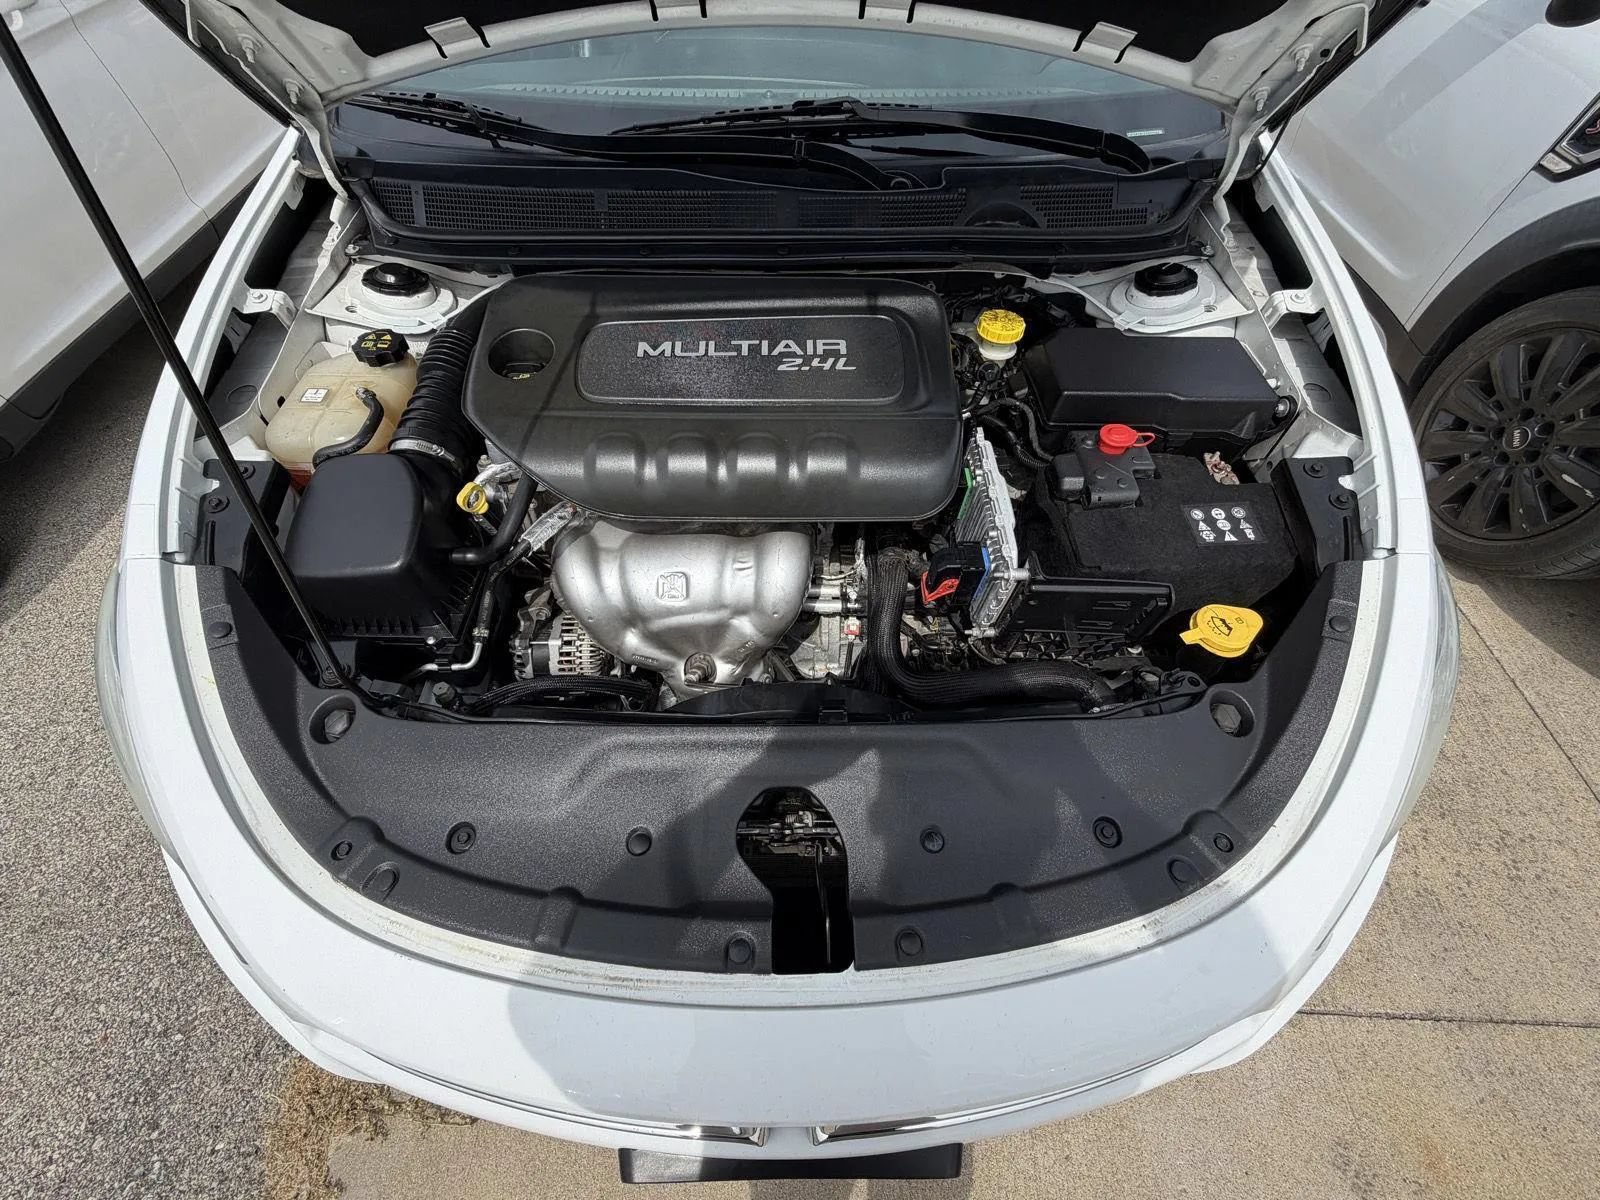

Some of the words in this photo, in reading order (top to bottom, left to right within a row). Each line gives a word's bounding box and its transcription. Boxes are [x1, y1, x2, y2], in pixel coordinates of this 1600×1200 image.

[636, 339, 848, 358] MULTIAIR
[776, 357, 857, 372] 2.4L
[1512, 429, 1521, 448] MINI
